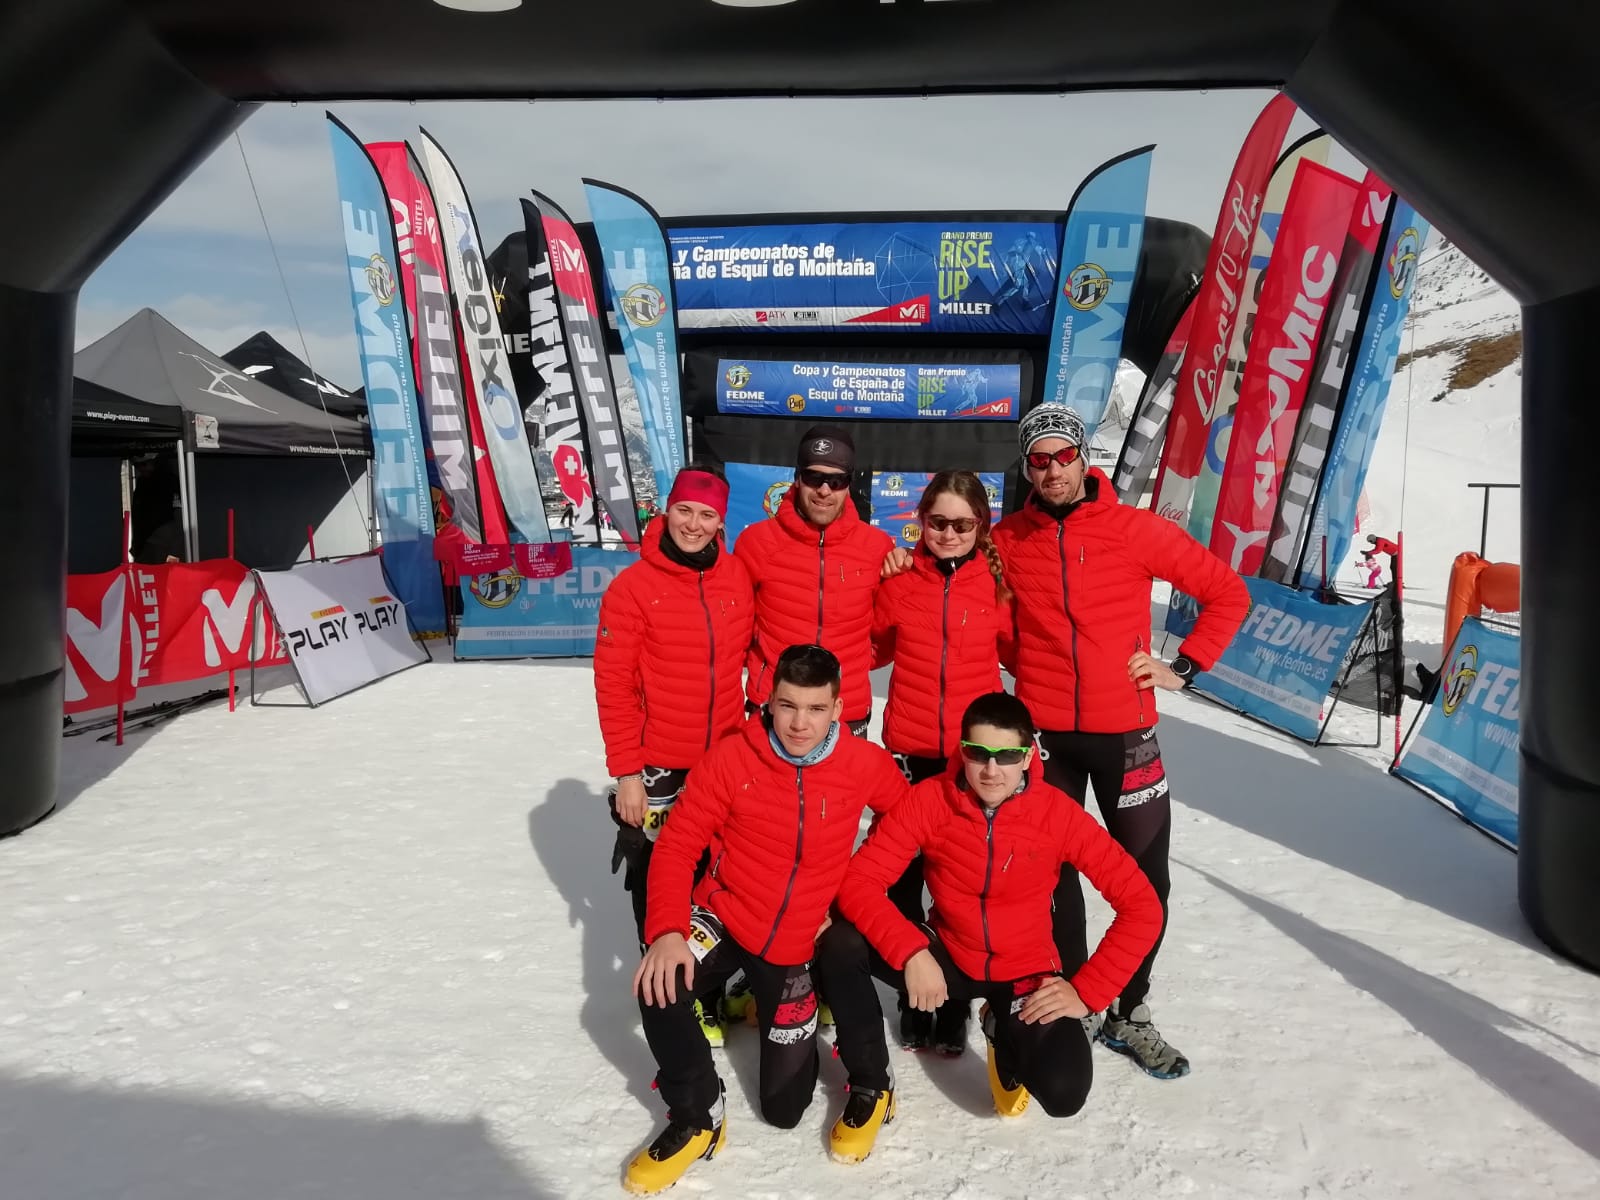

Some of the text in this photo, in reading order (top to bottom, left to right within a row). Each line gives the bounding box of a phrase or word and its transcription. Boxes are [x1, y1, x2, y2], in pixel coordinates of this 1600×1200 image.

[941, 231, 993, 240] GRAND PREMIO
[677, 243, 835, 266] y Campeonatos de
[696, 262, 717, 279] de
[721, 260, 768, 281] Esquí
[773, 260, 795, 277] de
[799, 258, 875, 277] Montaña
[938, 270, 970, 301] UP
[939, 303, 993, 315] MILLET
[1058, 315, 1074, 362] montaña
[1363, 303, 1389, 378] montaña
[793, 364, 906, 378] Copa y Campeonatos
[918, 368, 966, 376] Gran Premio
[1058, 365, 1067, 382] de
[833, 377, 905, 390] de España de
[918, 376, 946, 394] RISE
[726, 391, 765, 400] FEDME
[840, 390, 854, 401] de
[857, 389, 905, 402] Montaña
[917, 394, 935, 409] UP
[354, 603, 399, 635] PLAY
[288, 616, 349, 667] PLAY
[1241, 603, 1350, 664] FEDME
[1254, 645, 1329, 682] www.fedme.es
[650, 810, 669, 829] 30
